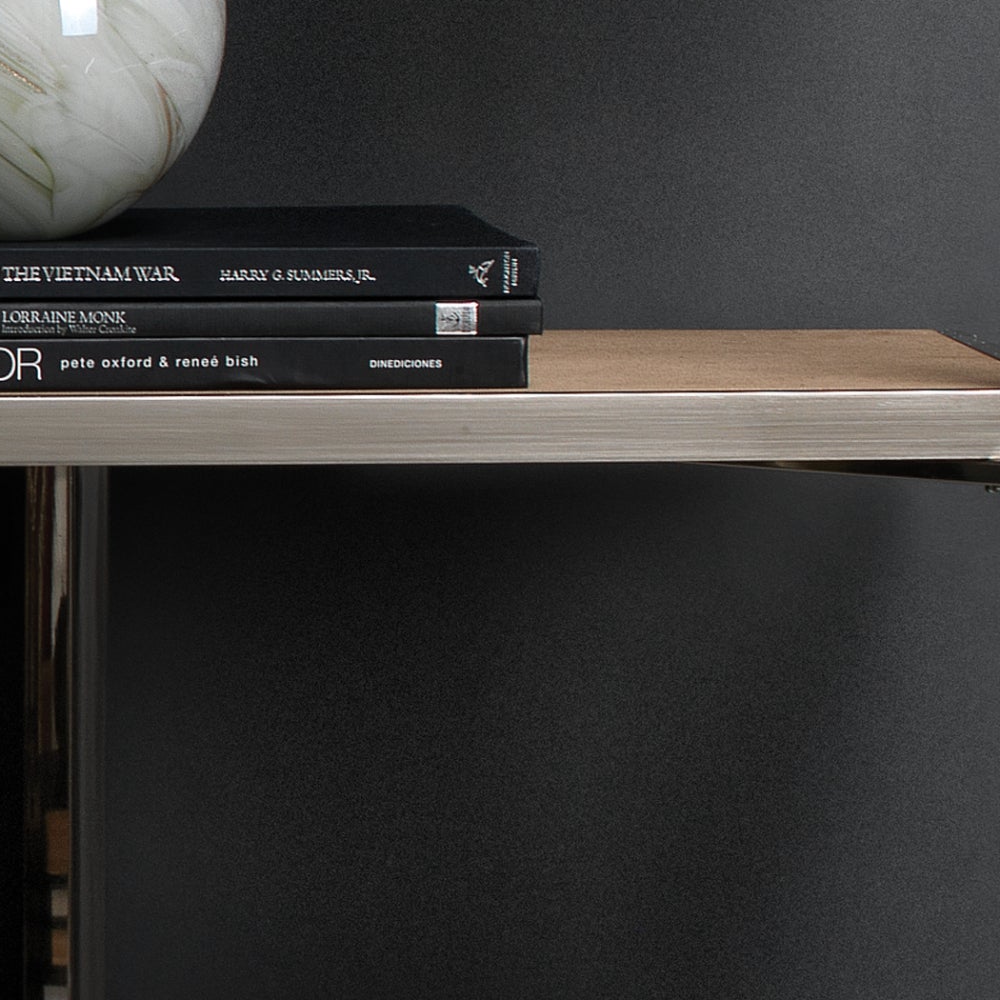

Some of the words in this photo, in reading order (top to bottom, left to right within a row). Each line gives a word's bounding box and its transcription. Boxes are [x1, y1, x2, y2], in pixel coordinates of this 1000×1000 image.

[1, 266, 41, 282] THE
[41, 266, 132, 282] VIETNAM
[132, 266, 181, 282] WAR
[219, 269, 269, 282] HARRY
[271, 269, 285, 281] G.
[1, 310, 76, 324] LORRAINE
[79, 310, 127, 324] MONK
[60, 357, 96, 371] pete
[101, 356, 153, 369] oxford
[158, 356, 170, 369] &
[175, 355, 219, 368] reneé
[225, 354, 260, 367] bish
[369, 359, 443, 369] DINEDICIONES
